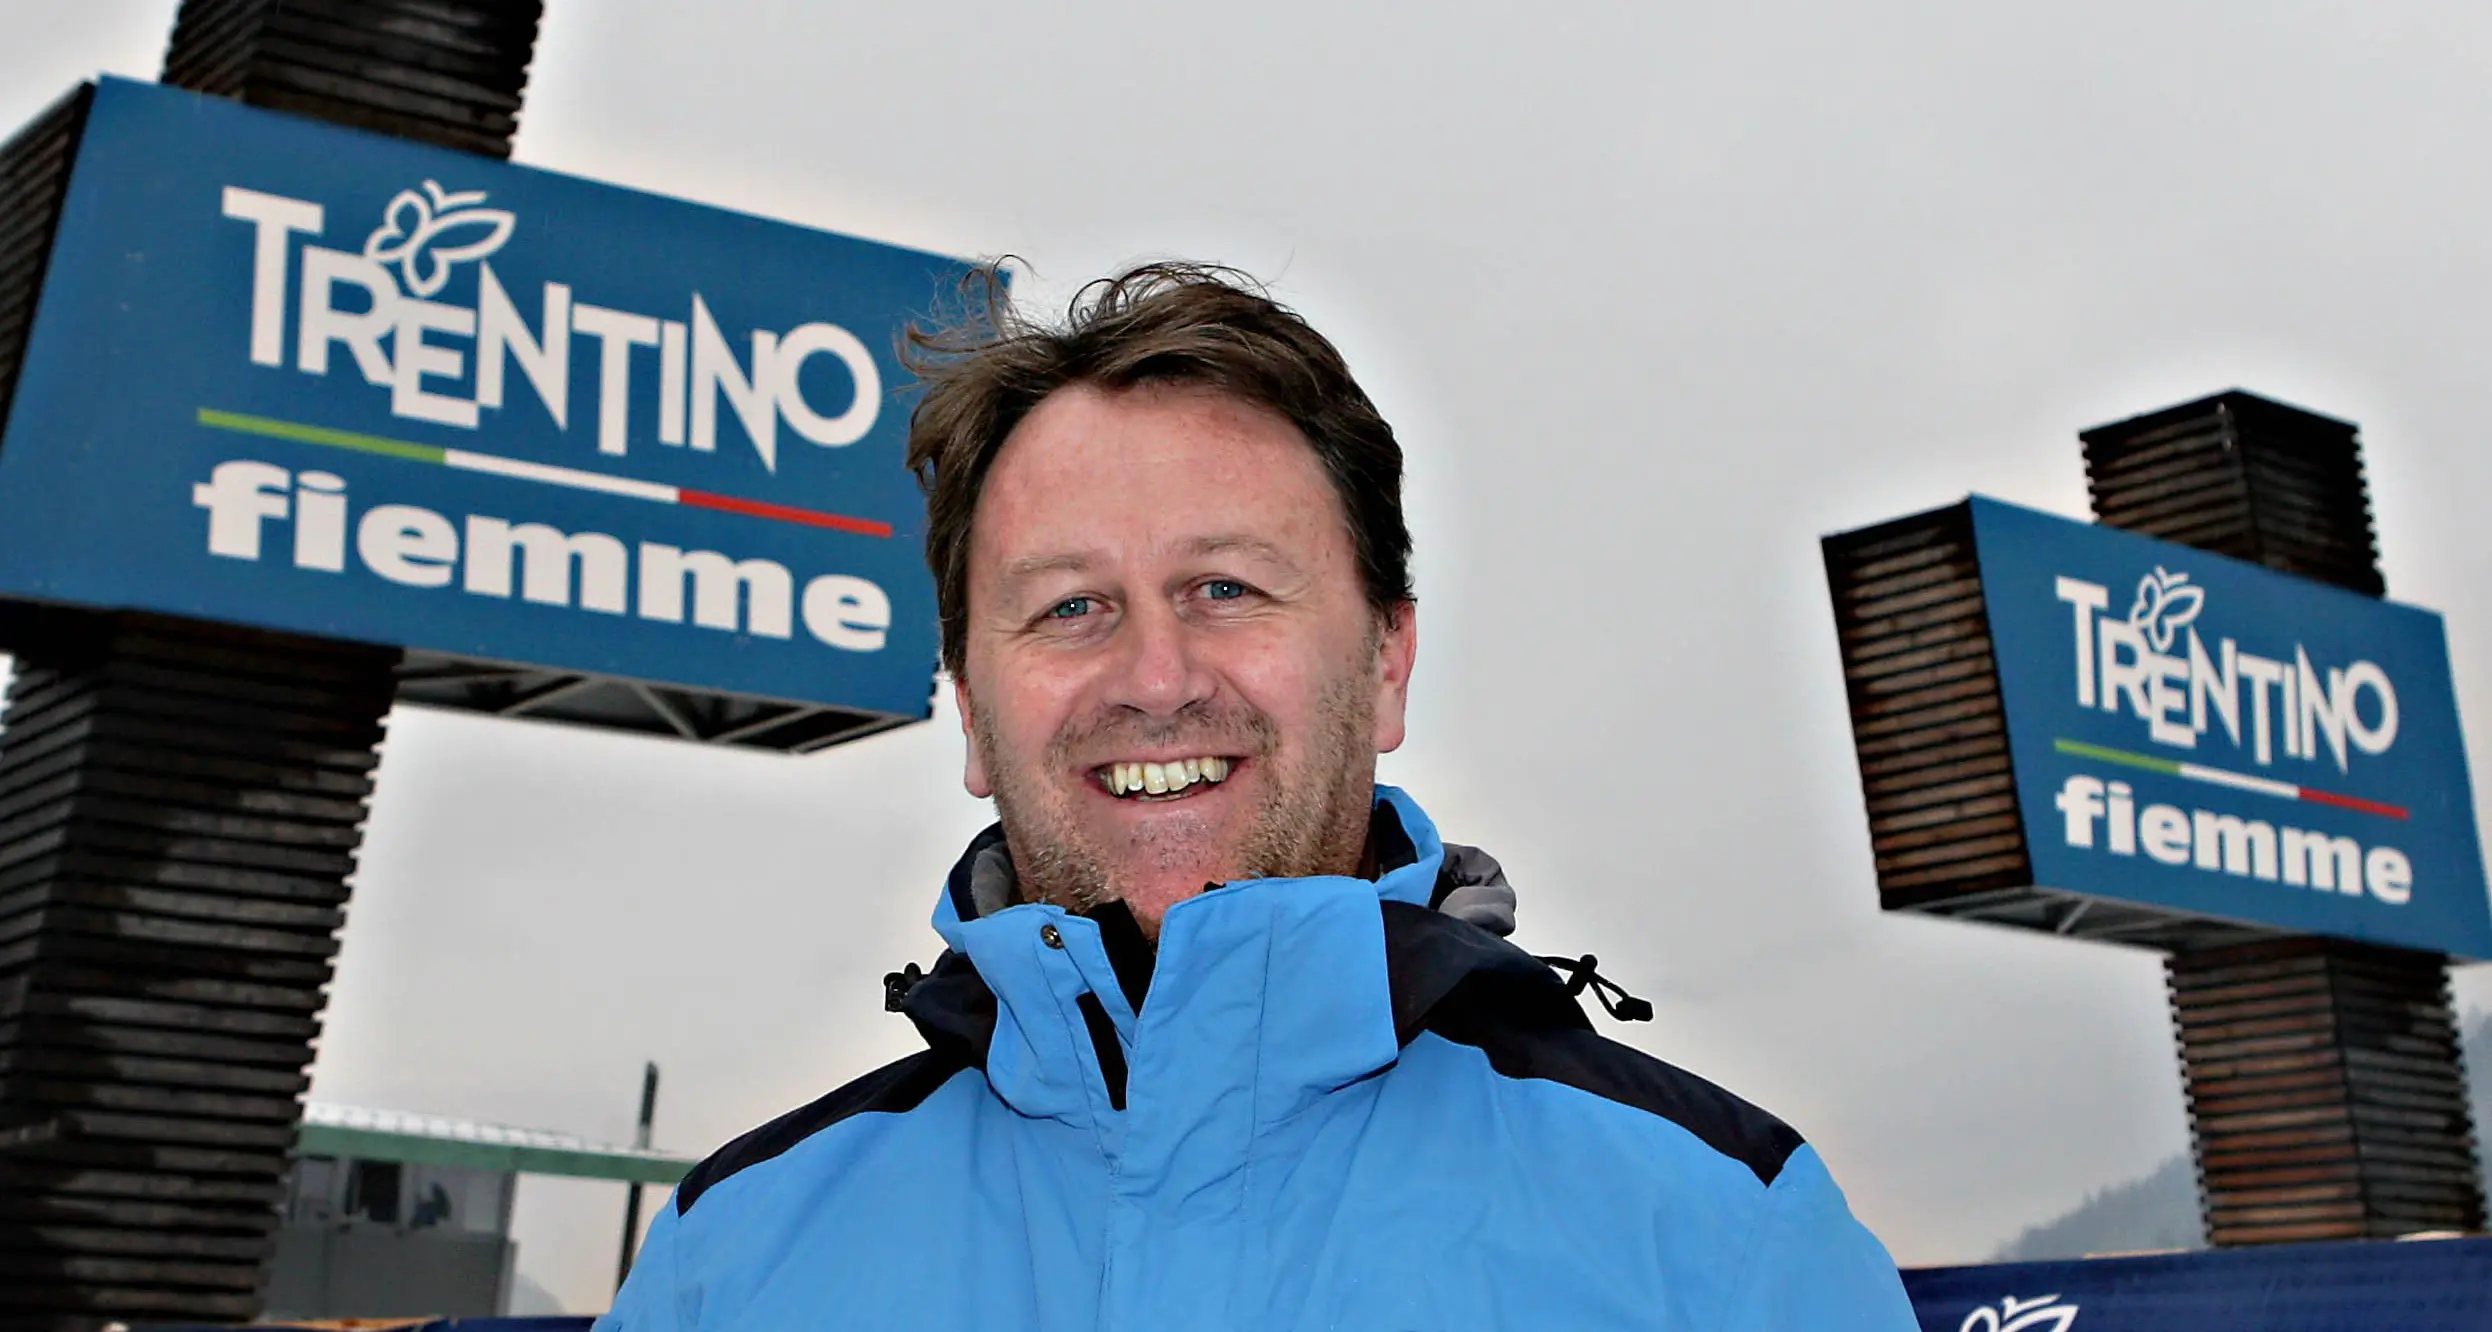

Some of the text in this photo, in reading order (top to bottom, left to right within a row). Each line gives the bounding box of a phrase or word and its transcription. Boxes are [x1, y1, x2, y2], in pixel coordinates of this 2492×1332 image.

[222, 186, 882, 475] TRENTINO
[193, 460, 892, 652] fiemme
[2055, 575, 2400, 775] TRENTINO
[2055, 775, 2413, 905] fiemme
